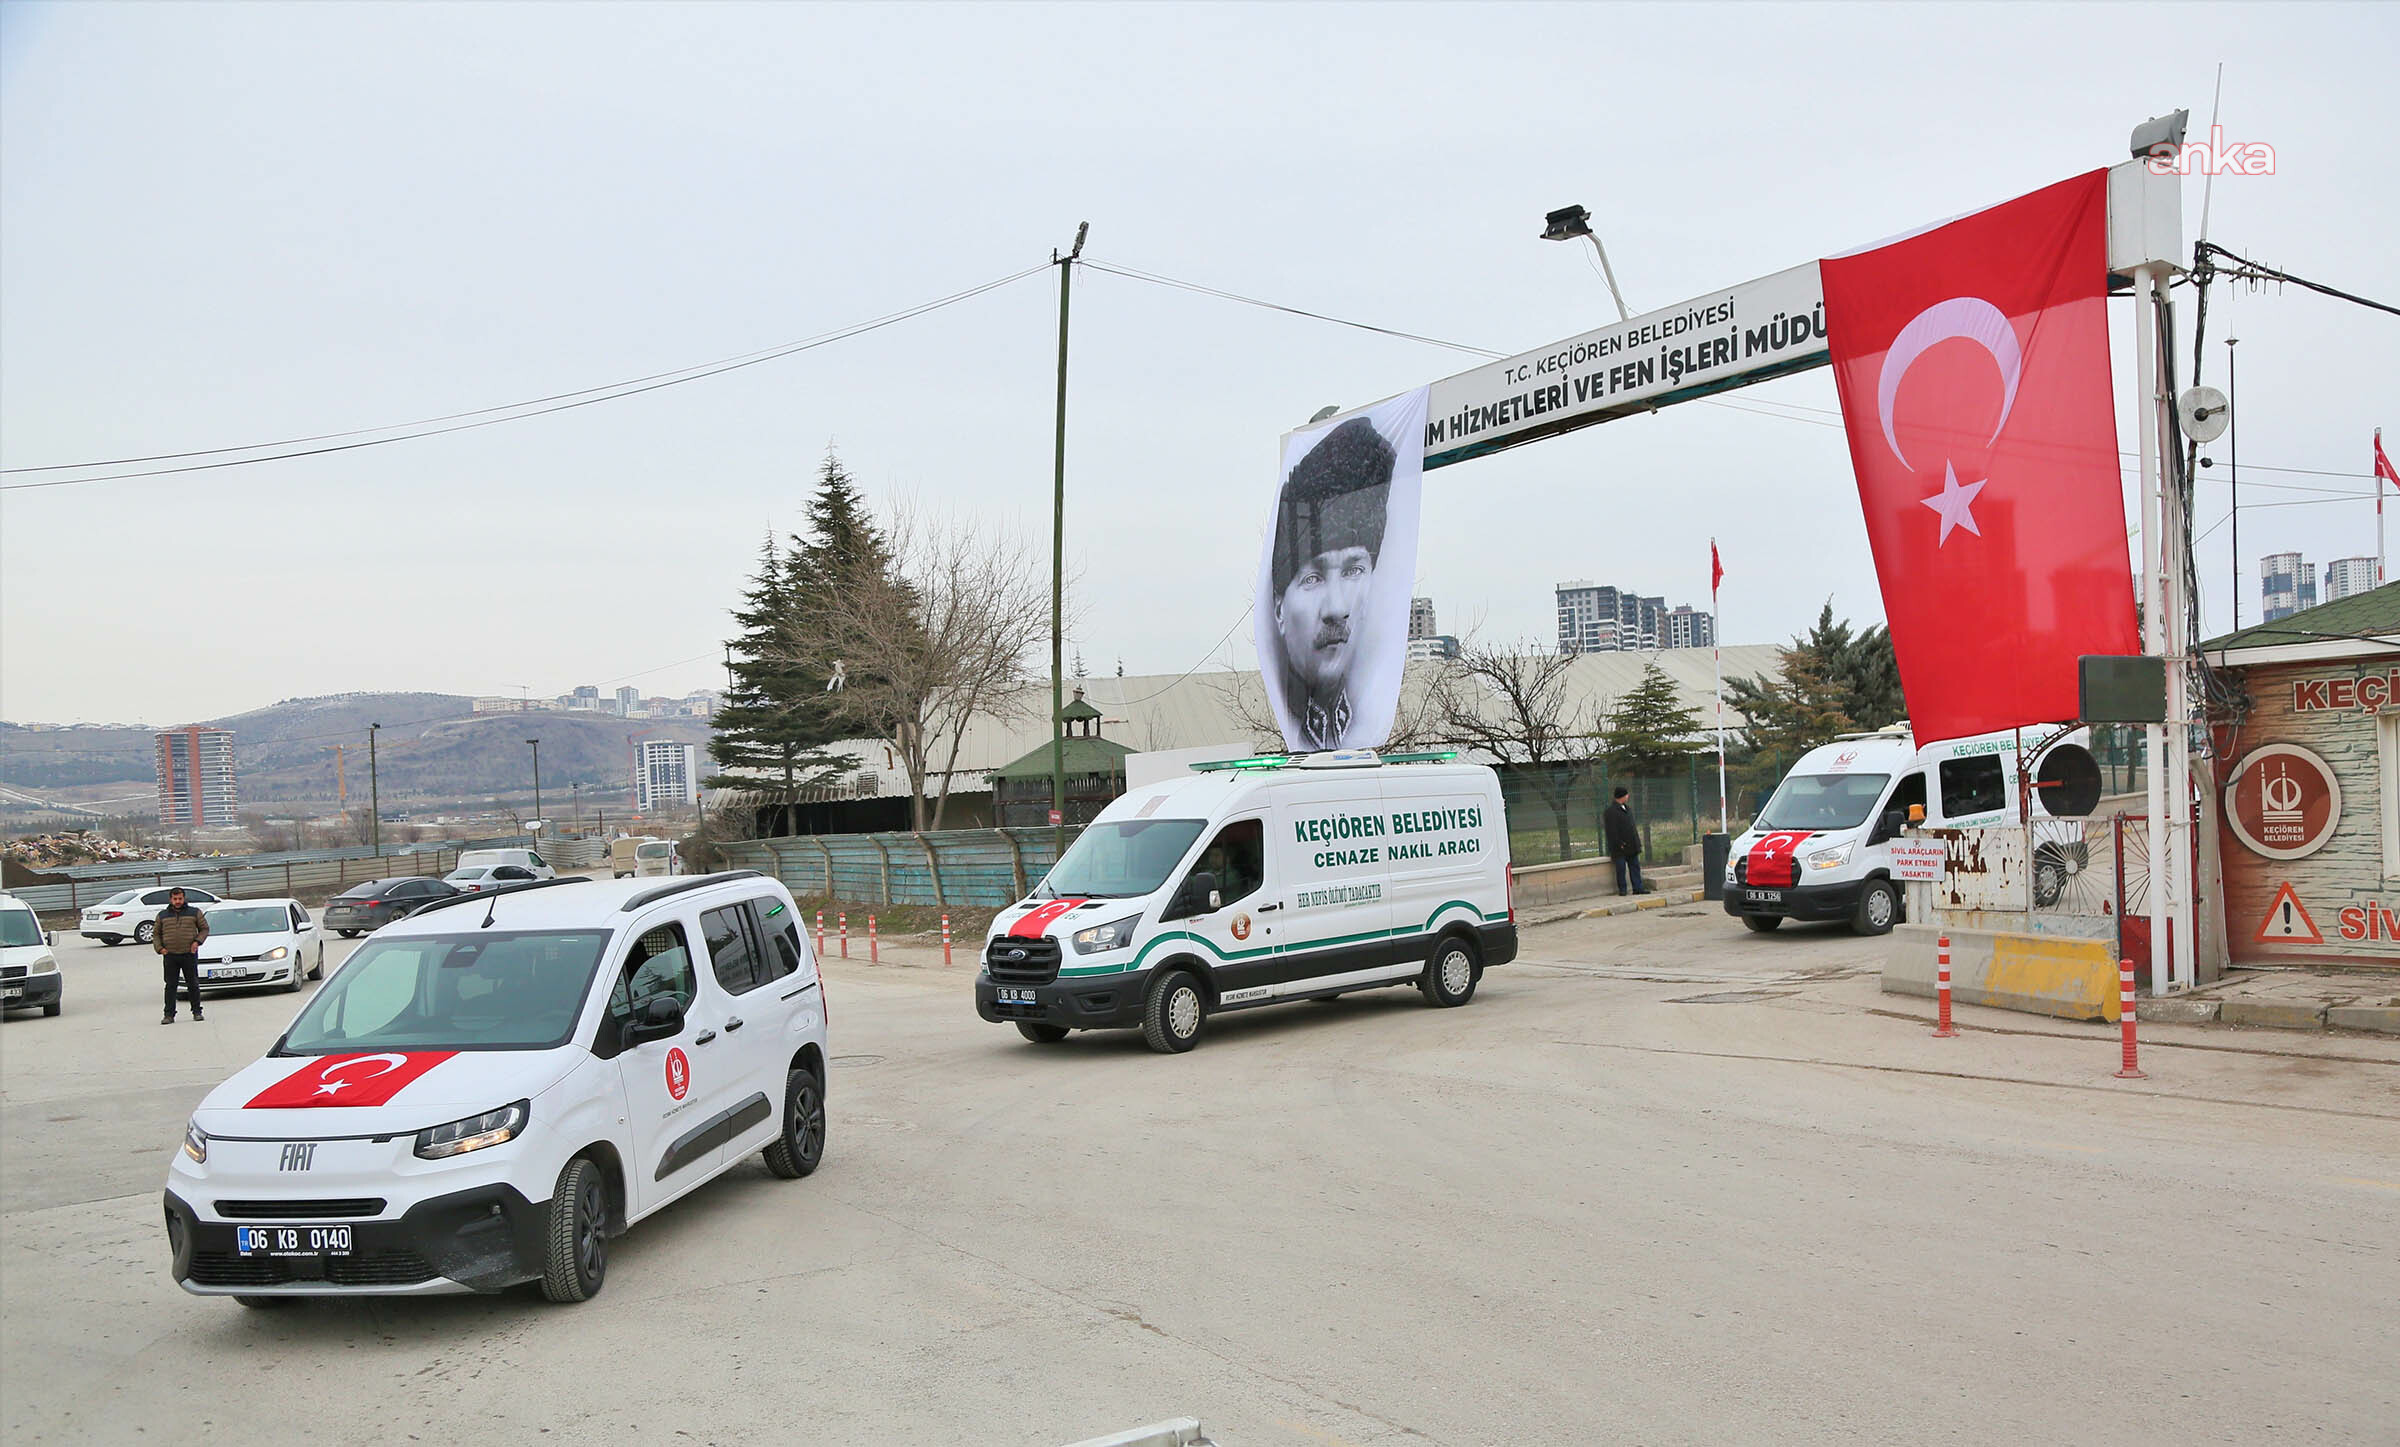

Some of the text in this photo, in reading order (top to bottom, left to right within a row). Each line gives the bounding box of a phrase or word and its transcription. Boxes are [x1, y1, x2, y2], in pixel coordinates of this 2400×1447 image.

[1505, 295, 1735, 385] T.C. KEÇİÖREN BELEDİYESİ
[1450, 374, 1569, 440] HİZMETLERİ
[1574, 371, 1604, 403] VE
[1609, 357, 1654, 394] FEN
[1661, 324, 1738, 386] İŞLERİ
[1745, 301, 1828, 358] MÜDÜ
[2294, 668, 2400, 714] KEÇİ
[1295, 803, 1482, 847] KEÇİÖREN BELEDİYESİ
[2263, 825, 2305, 842] KEÇİÖREN BELEDİYESİ
[1314, 838, 1480, 868] CENAZE NAKİL ARACI
[1896, 859, 1913, 867] PARK
[1297, 892, 1310, 908] HER
[1311, 888, 1328, 906] NEFİS
[279, 1143, 317, 1171] FIAT
[248, 1229, 268, 1249] 06
[278, 1229, 298, 1249] KB
[310, 1229, 349, 1249] 0140
